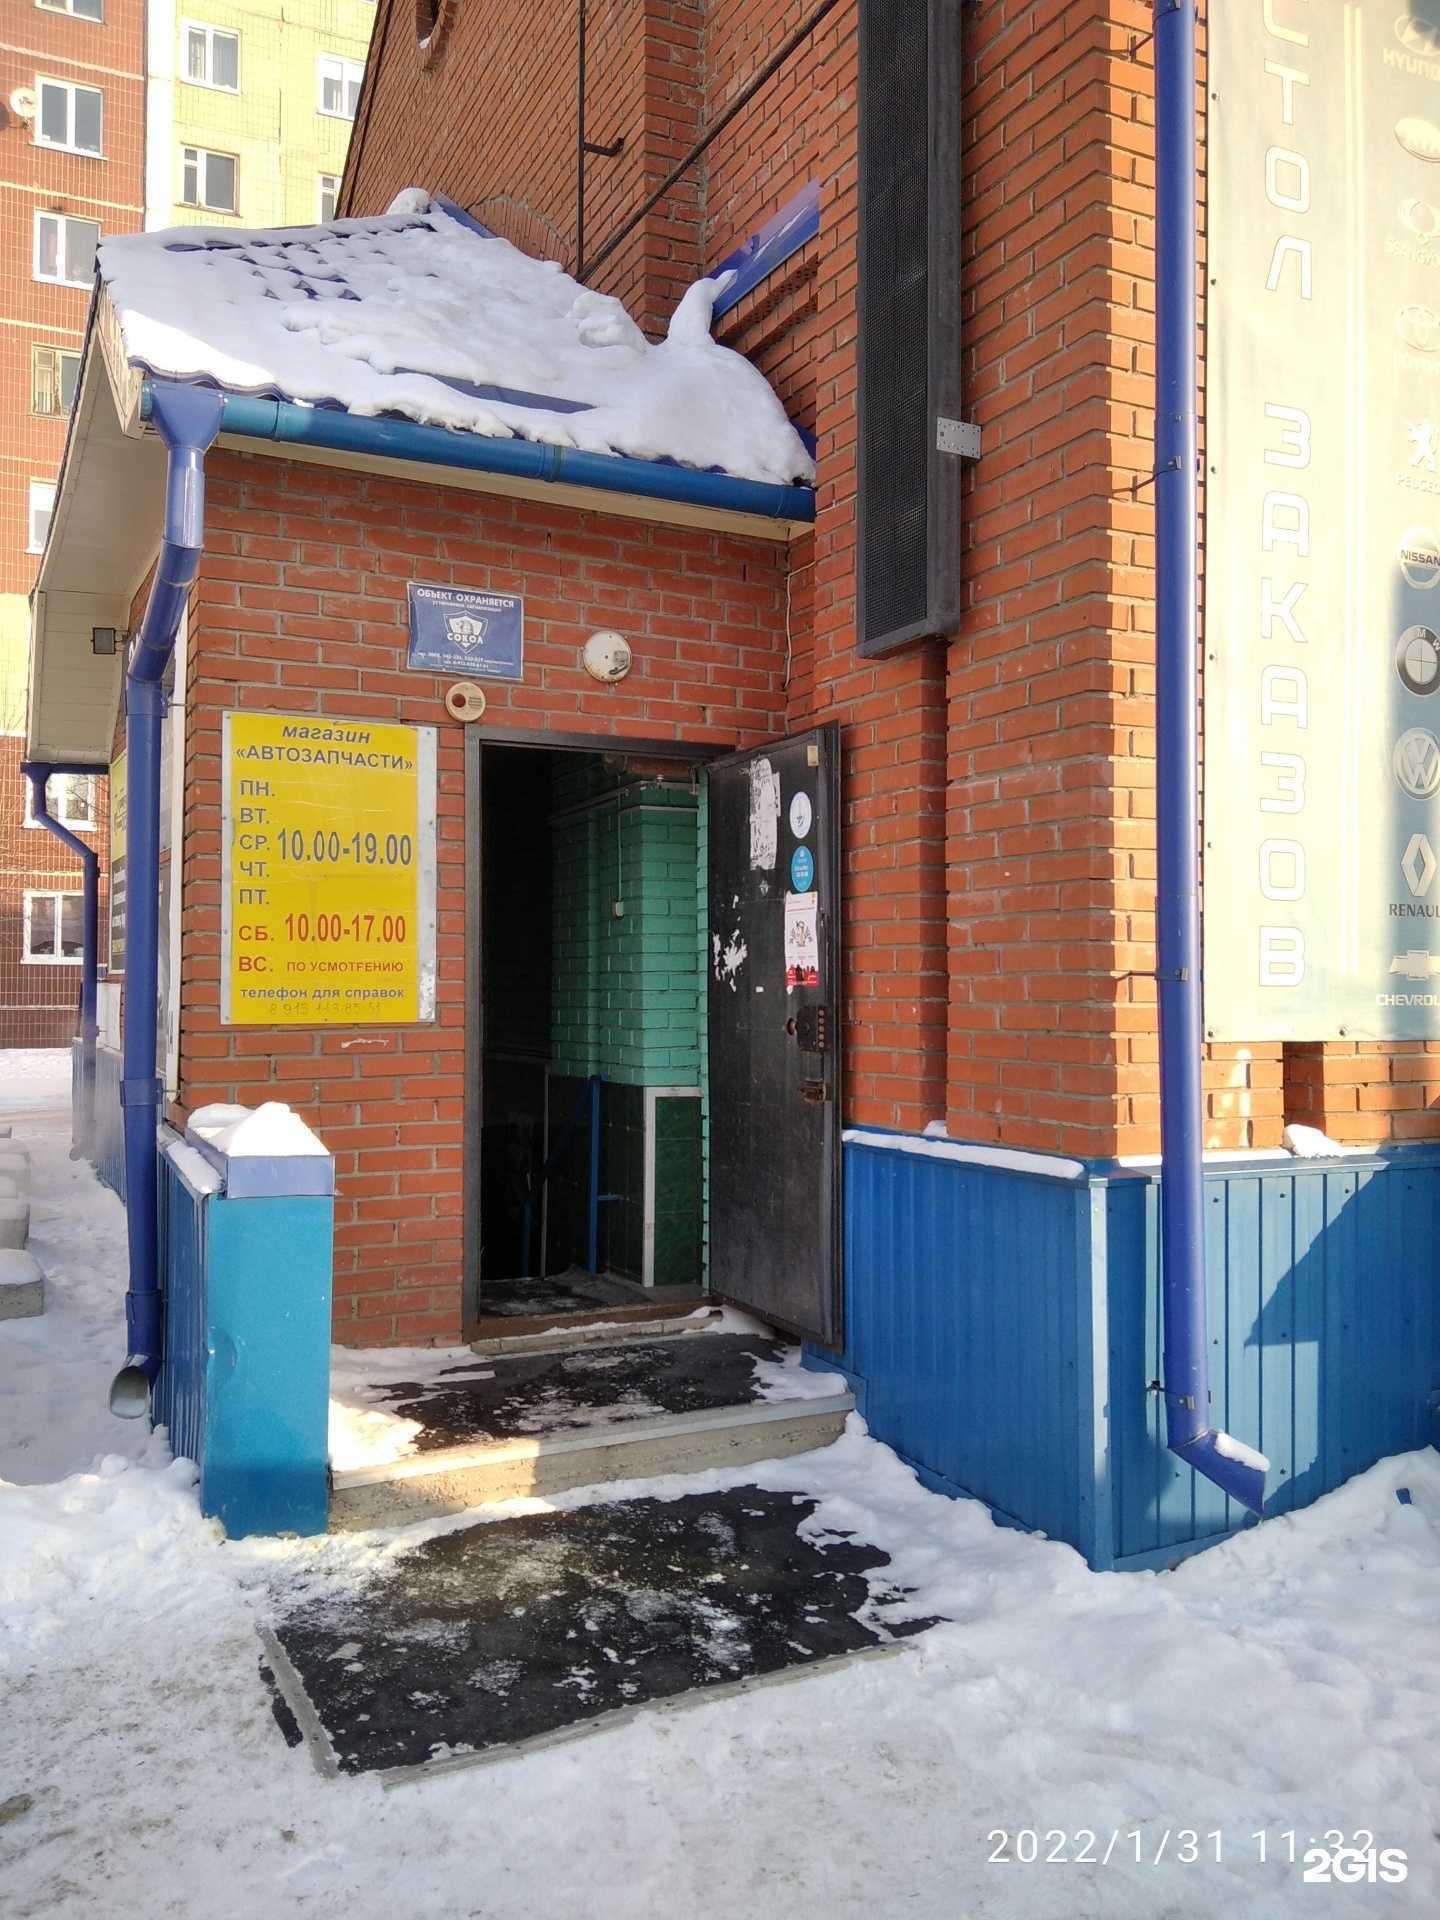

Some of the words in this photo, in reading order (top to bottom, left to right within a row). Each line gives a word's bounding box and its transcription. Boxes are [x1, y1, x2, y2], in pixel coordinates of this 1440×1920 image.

[1400, 548, 1440, 568] NISSAN
[416, 588, 453, 601] ОБЪЕКТ
[455, 592, 515, 608] ОХРАНЯЕТСЯ
[446, 632, 484, 645] СОКОЛ
[1257, 401, 1313, 988] ЗАКАЗОВ
[282, 723, 371, 744] магазин
[236, 744, 414, 770] «АВТОЗАПЧАСТИ»
[239, 780, 276, 797] ПН.
[240, 808, 270, 825] ВТ.
[239, 834, 270, 851] СР.
[277, 828, 412, 866] 10.00-19.00
[239, 861, 270, 878] ЧТ.
[239, 888, 270, 905] ПТ.
[238, 925, 275, 942] СБ.
[285, 913, 406, 943] 10.00-17.00
[238, 956, 273, 973] ВС.
[287, 961, 306, 972] ПО
[310, 961, 404, 973] УСМОТРЕНИЮ
[240, 986, 308, 1001] телефон
[312, 988, 341, 1000] для
[345, 988, 404, 1000] справок
